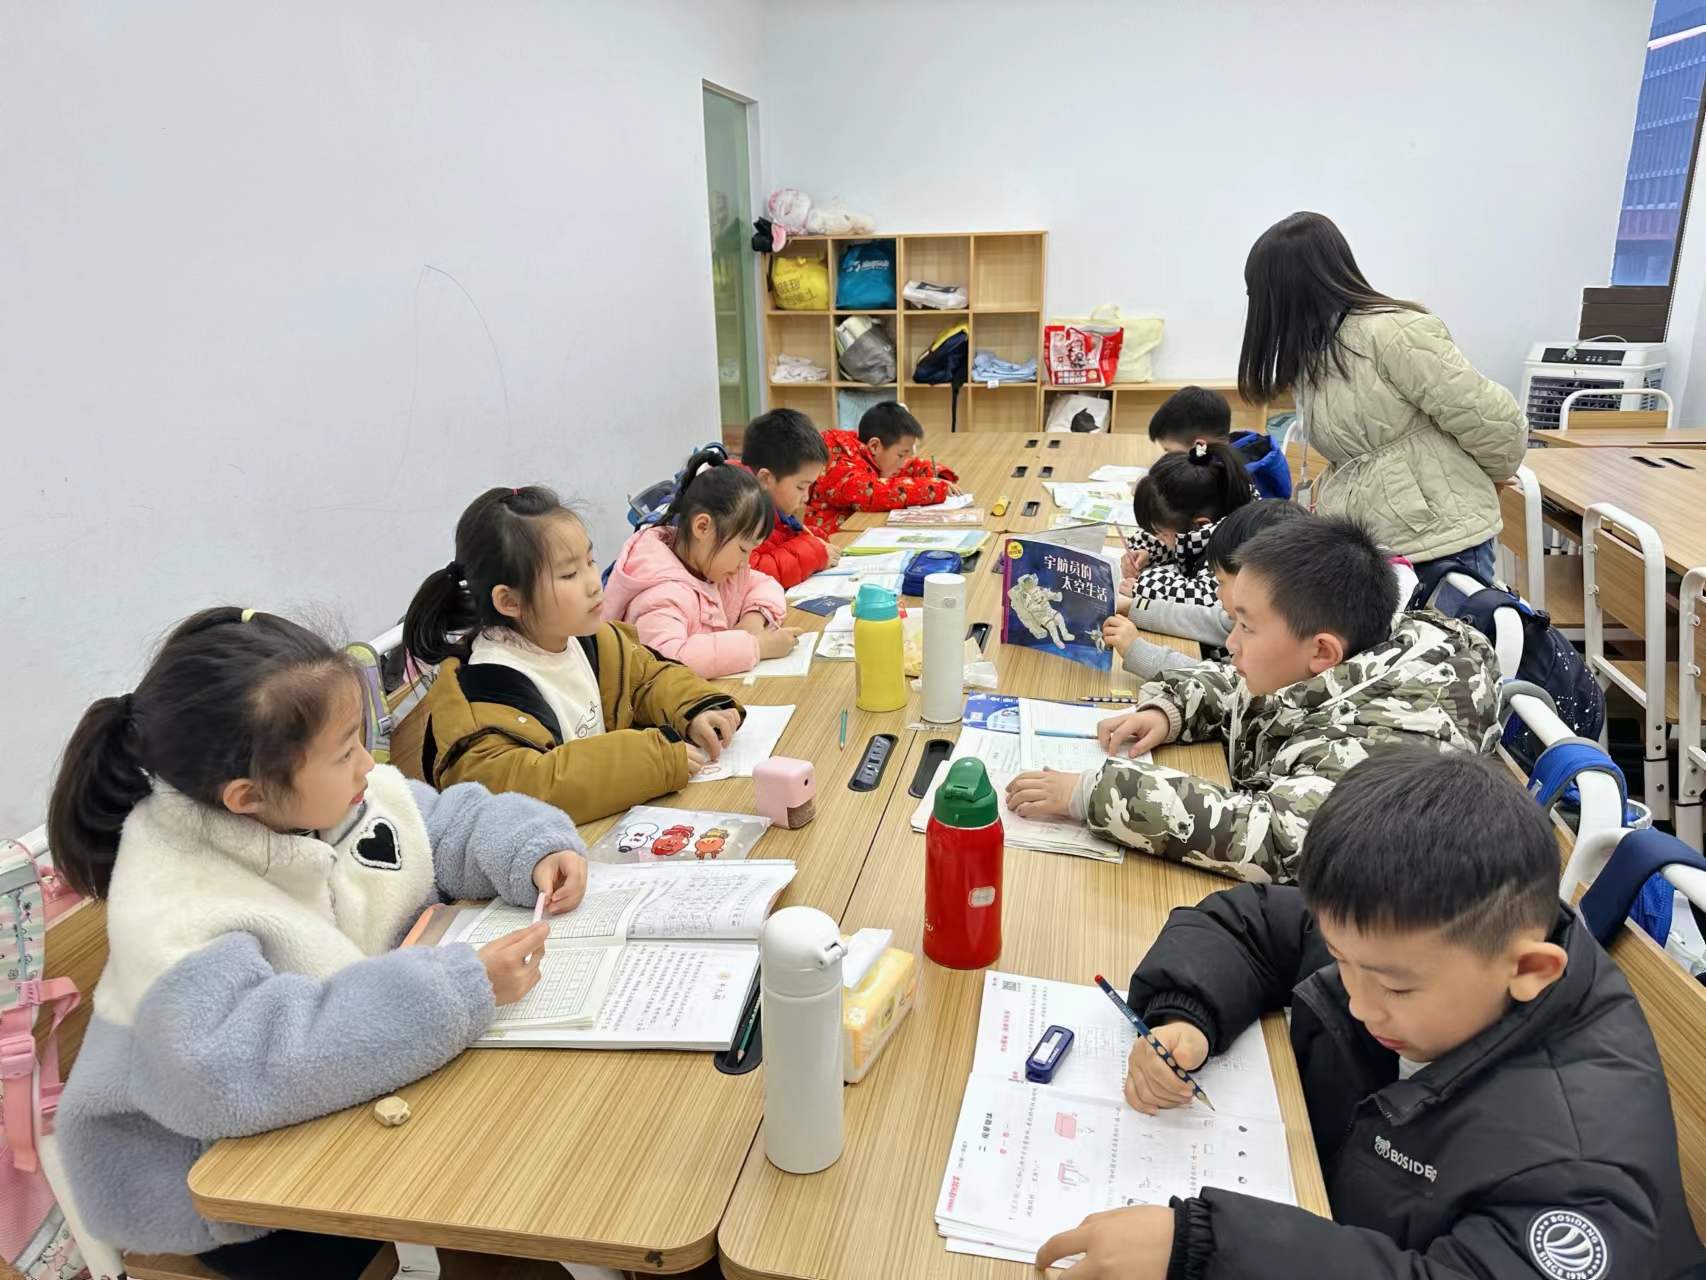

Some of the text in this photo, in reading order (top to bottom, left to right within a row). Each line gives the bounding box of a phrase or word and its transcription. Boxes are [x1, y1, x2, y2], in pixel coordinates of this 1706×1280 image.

[1044, 554, 1092, 580] 宇航员的
[1061, 575, 1107, 603] 太空生活
[981, 1112, 993, 1140] 观察物体
[1550, 1215, 1599, 1243] BOSIDENG
[1539, 1251, 1587, 1280] SINCE 1976
